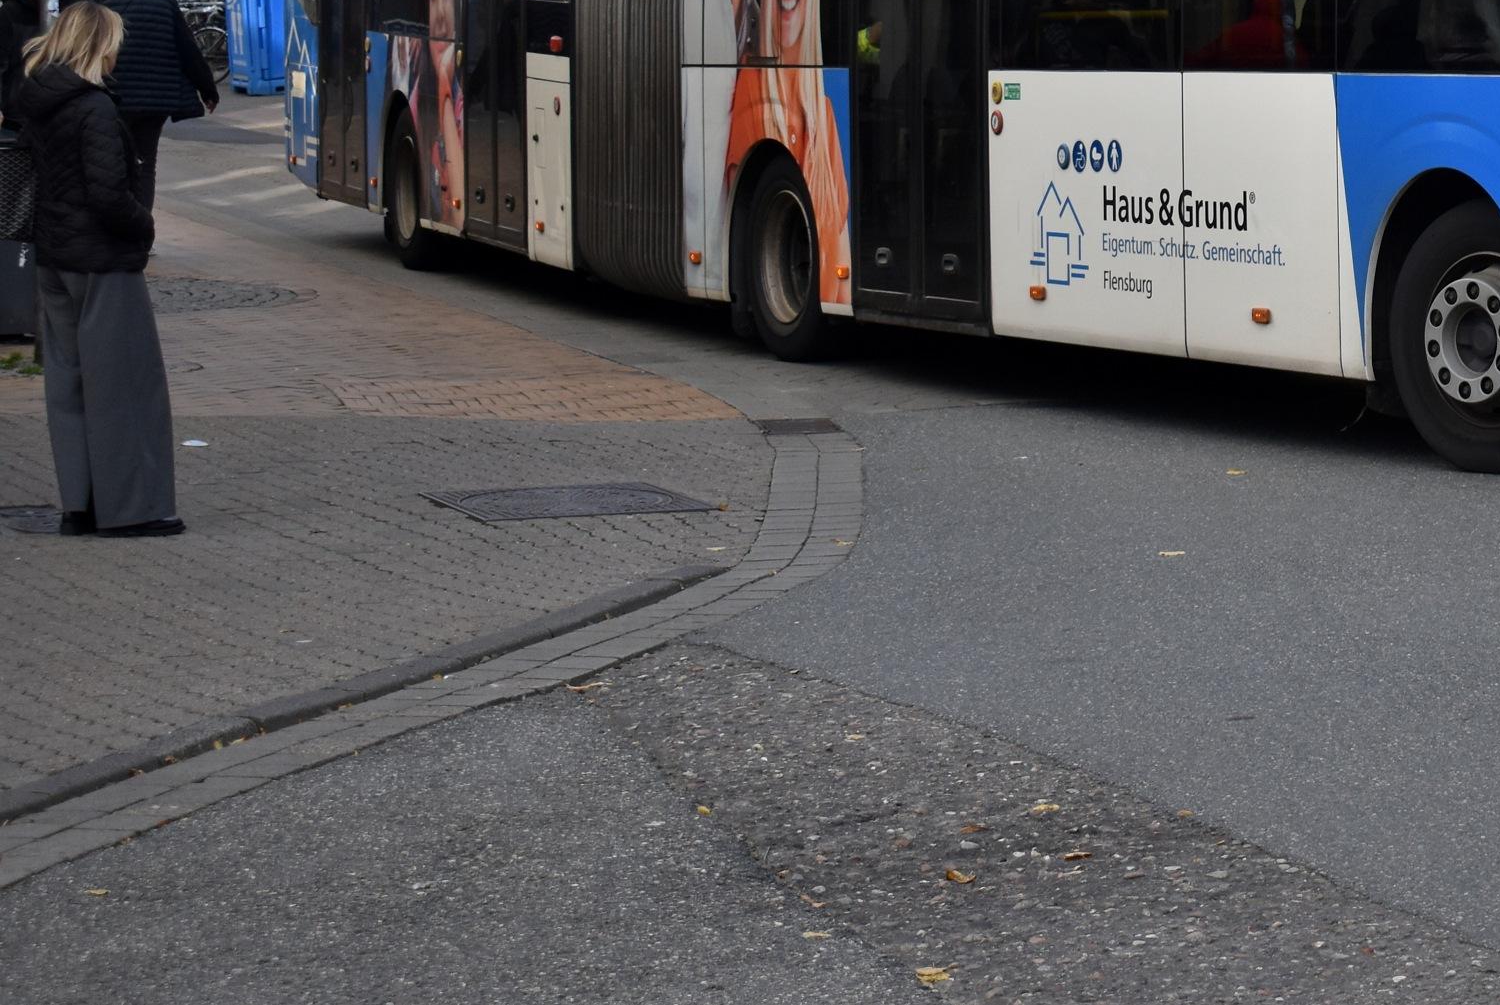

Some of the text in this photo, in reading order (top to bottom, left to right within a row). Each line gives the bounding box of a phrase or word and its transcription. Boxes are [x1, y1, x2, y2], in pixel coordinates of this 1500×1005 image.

[1102, 185, 1154, 224] Haus
[1158, 188, 1175, 226] &
[1102, 233, 1286, 267] Eigentum. Schutz. Gemeinschaft.
[1103, 270, 1153, 300] Flensburg
